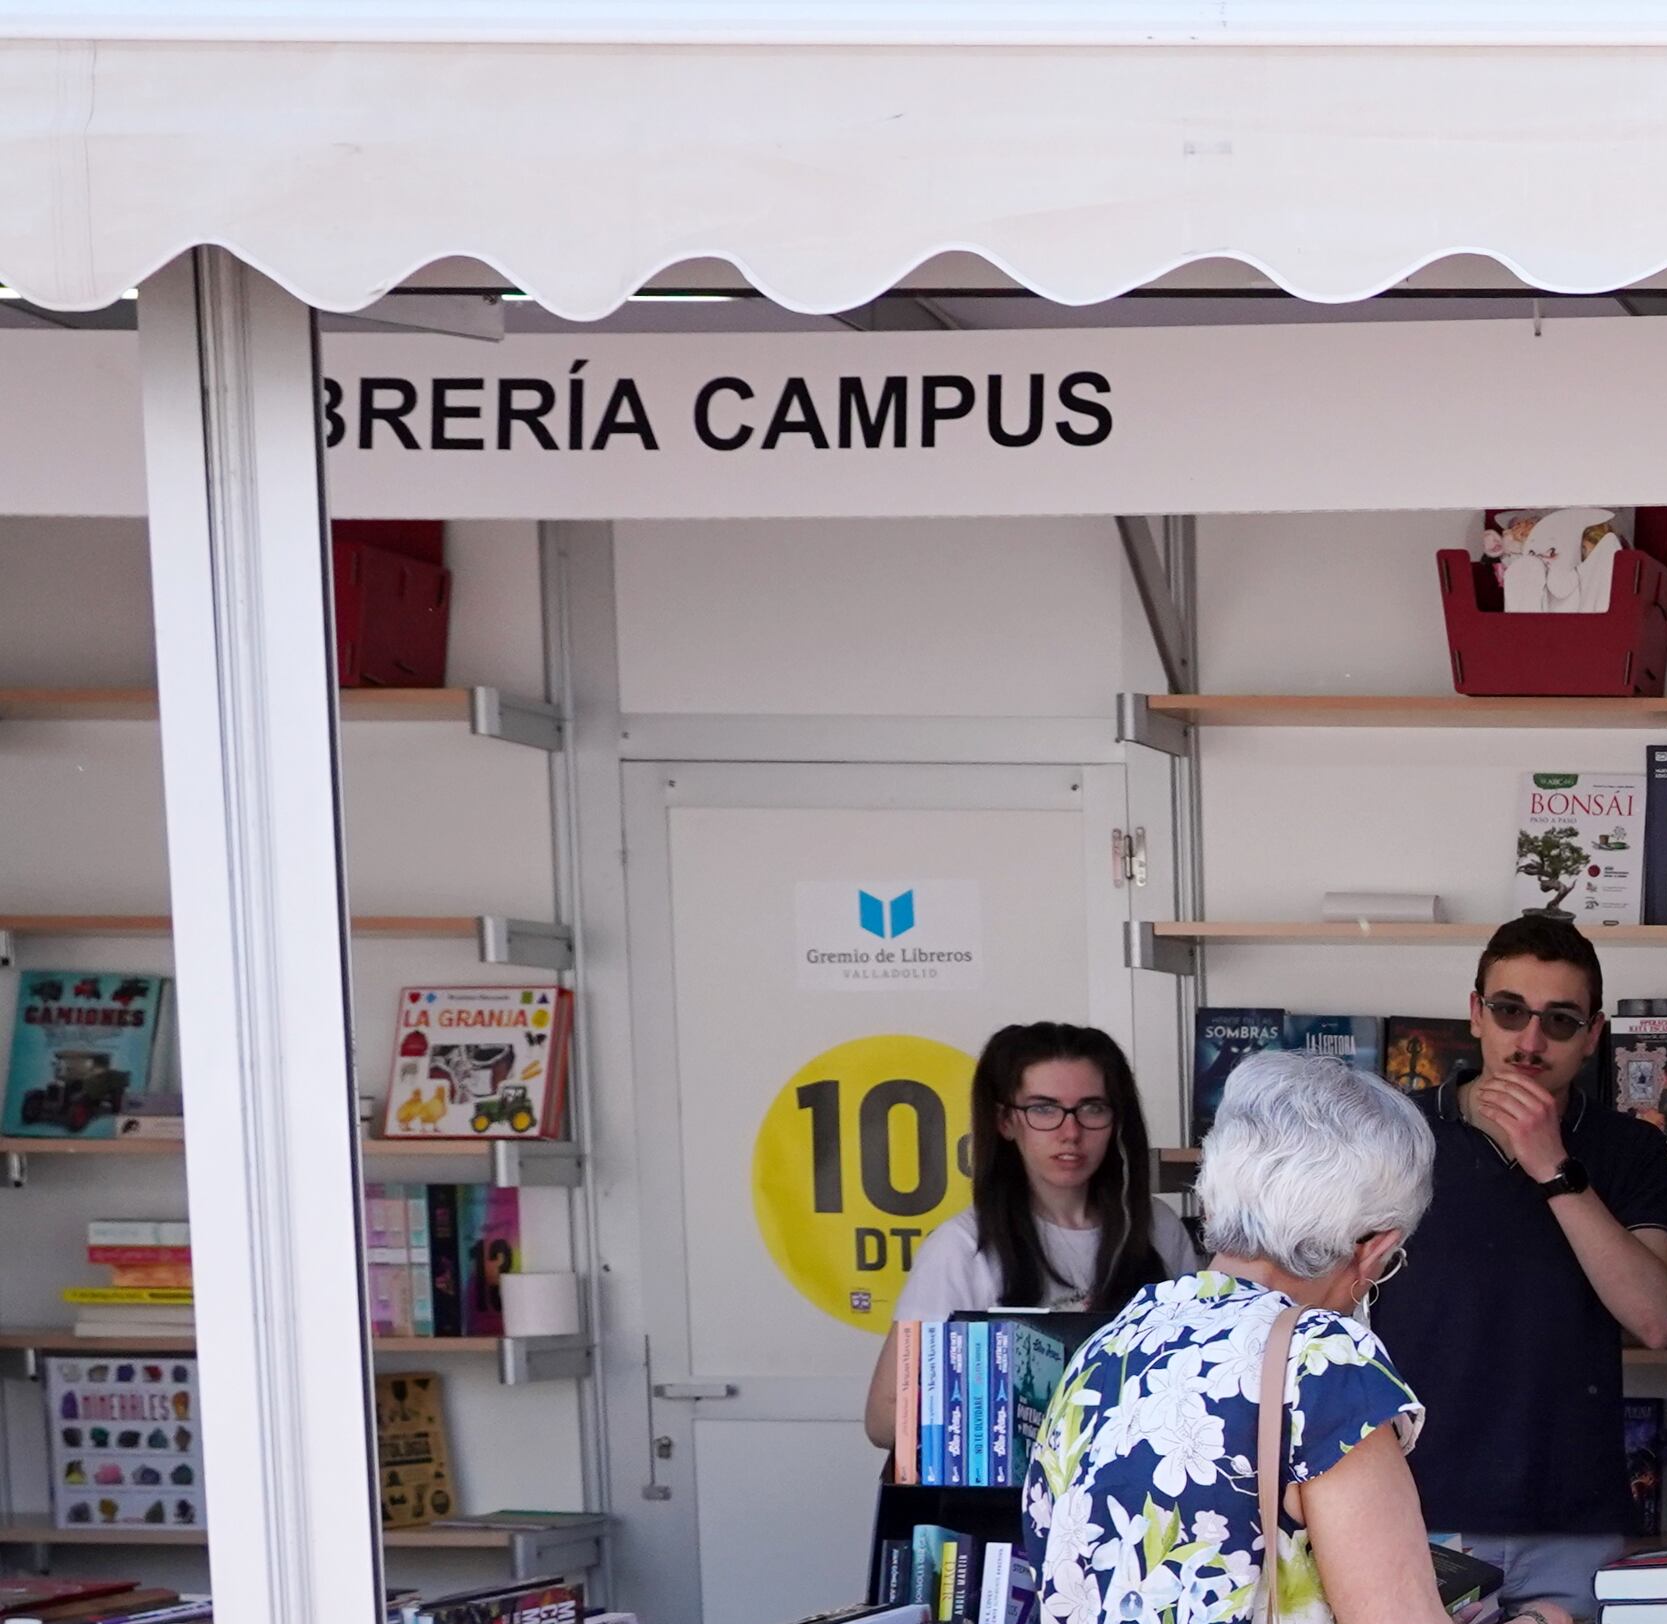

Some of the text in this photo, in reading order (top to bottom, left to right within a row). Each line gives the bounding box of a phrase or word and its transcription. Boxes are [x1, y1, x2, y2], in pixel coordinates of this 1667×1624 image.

[694, 371, 1113, 451] CAMPUS
[1531, 790, 1634, 816] BONSÁI
[807, 948, 972, 964] Gremio de Libreros
[843, 968, 938, 979] VALLADOLID
[404, 1007, 528, 1028] LA GRANJA
[1205, 1026, 1279, 1040] SOMBRAS
[797, 1079, 973, 1217] 10
[856, 1228, 932, 1272] DT
[927, 1362, 937, 1391] Megan
[973, 1432, 983, 1441] TE
[973, 1444, 984, 1455] NO
